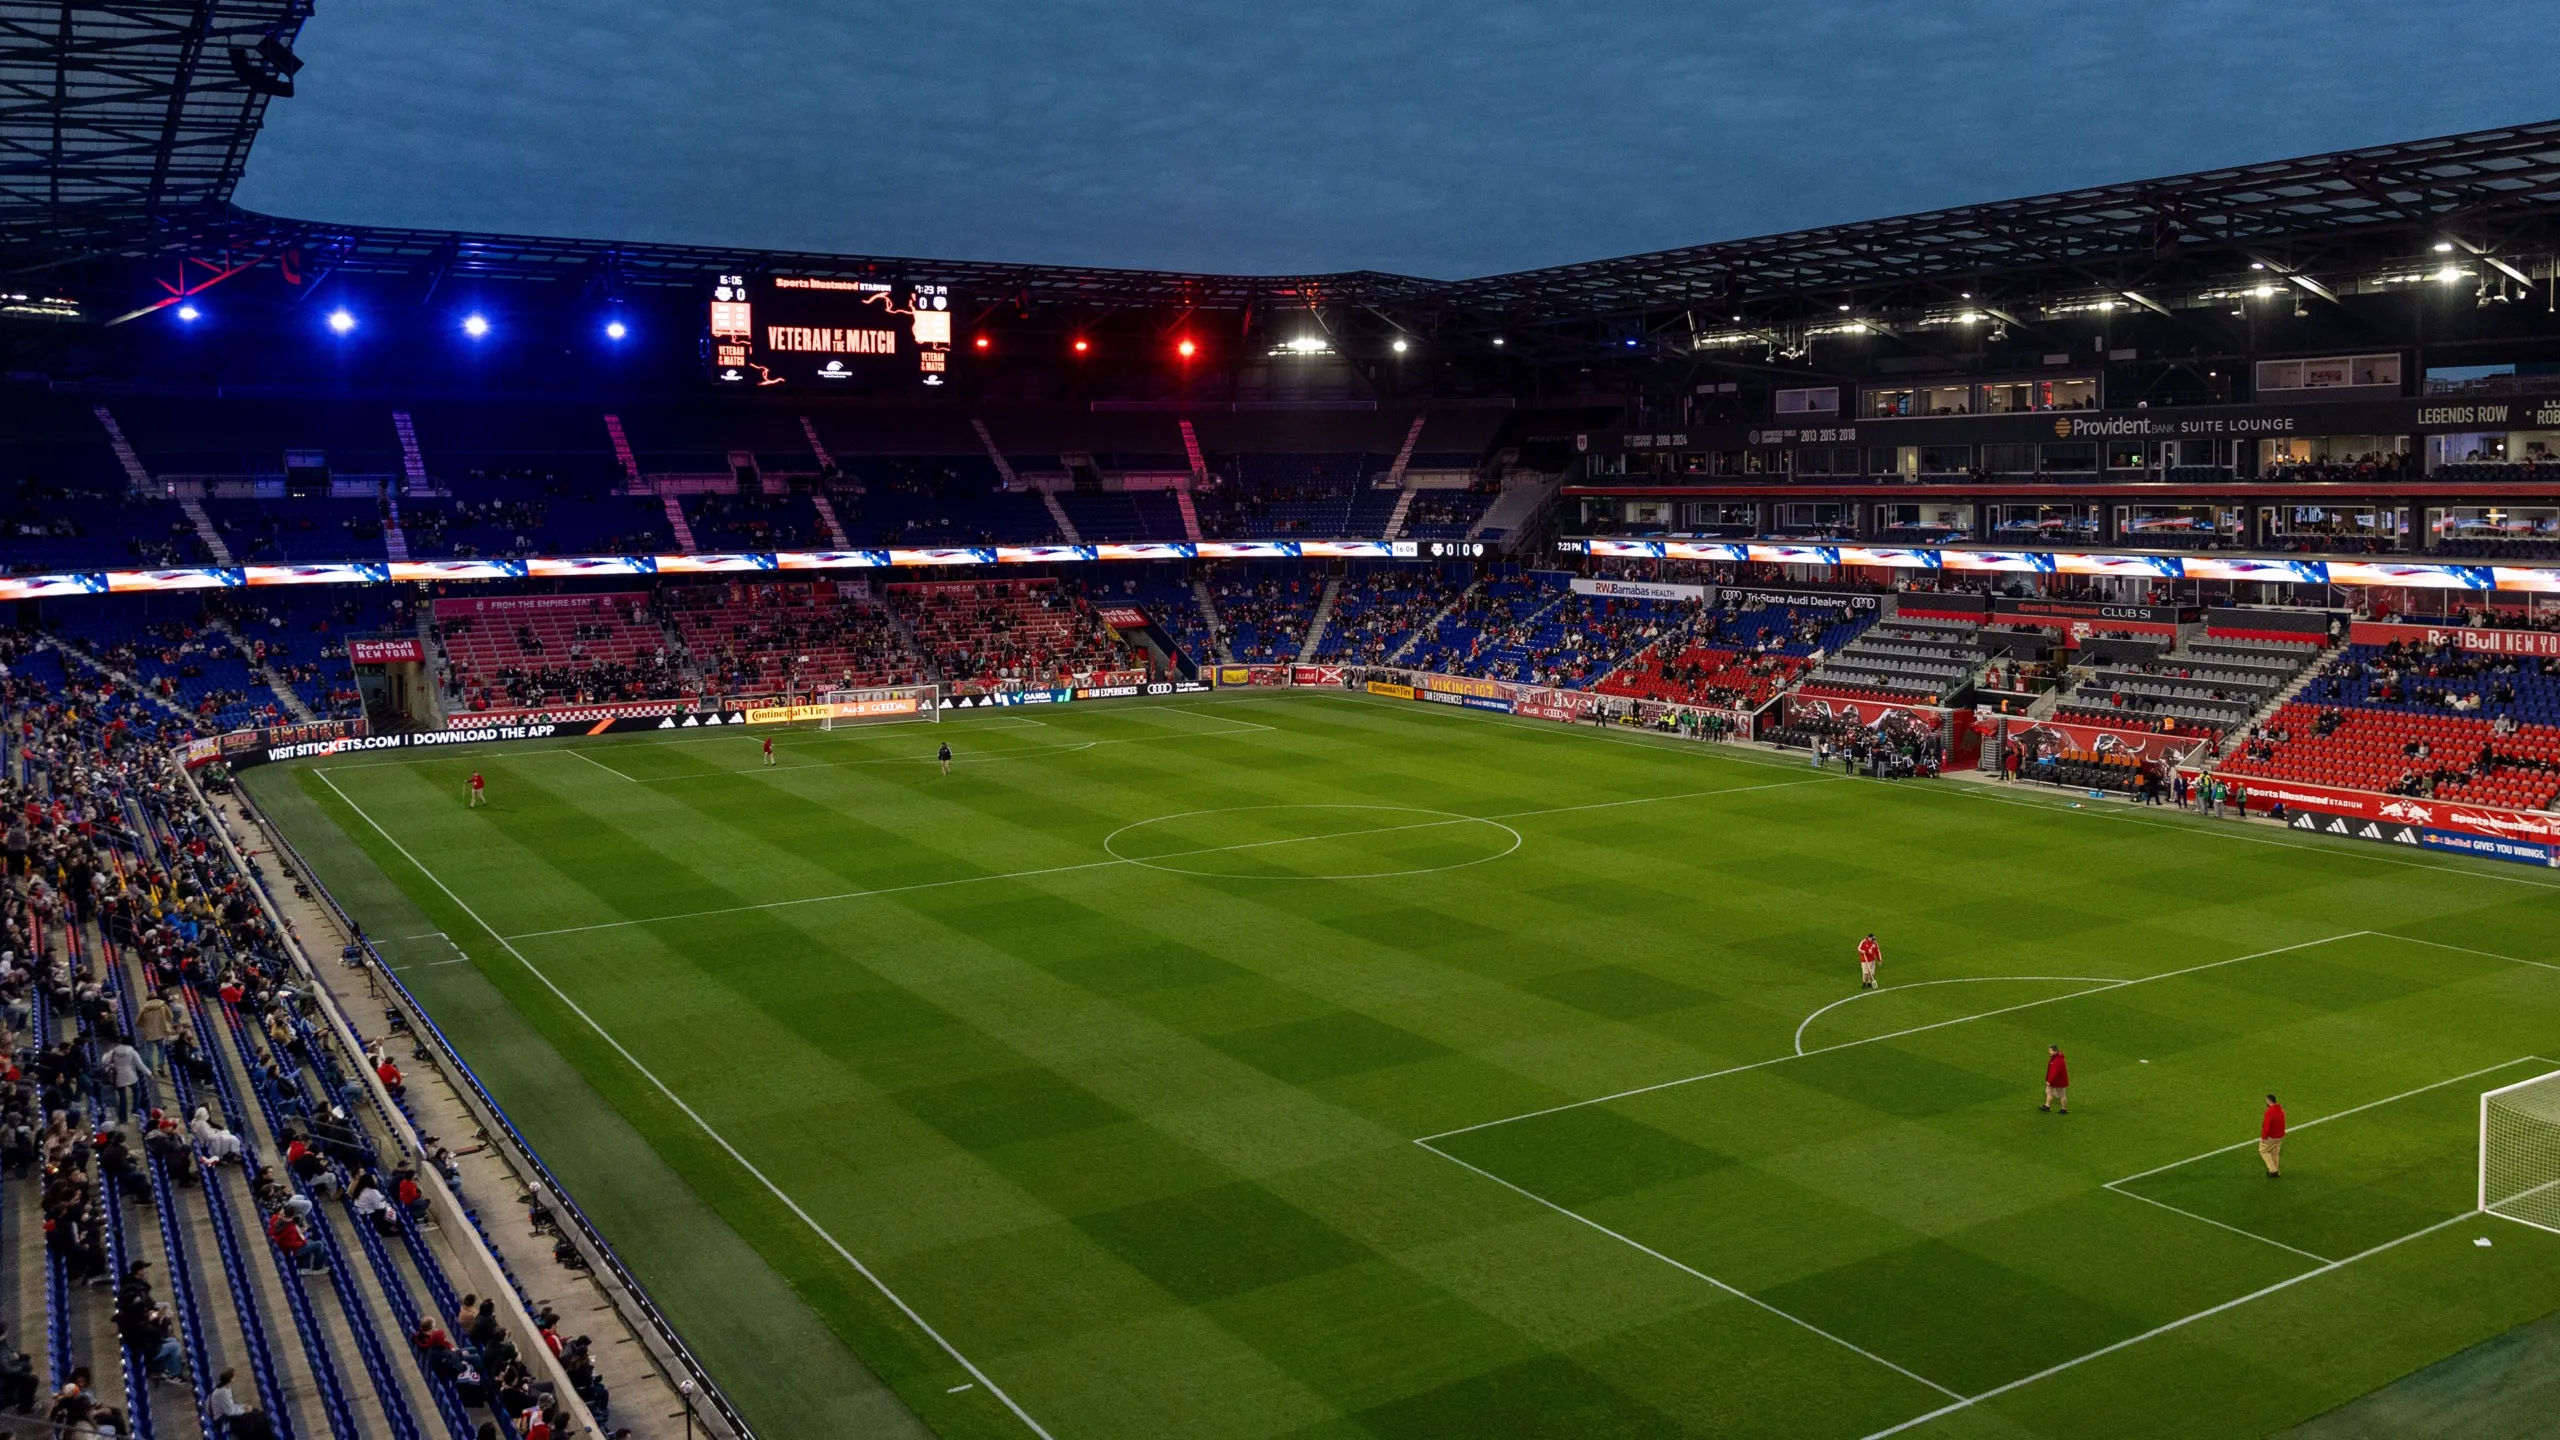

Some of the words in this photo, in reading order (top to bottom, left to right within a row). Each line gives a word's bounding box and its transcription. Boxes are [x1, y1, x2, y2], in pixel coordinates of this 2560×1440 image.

[776, 278, 809, 288] Sports
[810, 279, 859, 290] Illustrated
[860, 283, 892, 291] STADIUM
[737, 288, 746, 301] 0
[919, 297, 928, 309] 0
[768, 326, 831, 351] VETERAN
[834, 329, 843, 340] OF
[833, 341, 845, 352] THE
[846, 329, 895, 354] MATCH
[719, 346, 744, 355] VETERAN
[921, 352, 944, 361] VETERAN
[2418, 406, 2474, 424] LEGENDS
[2478, 405, 2508, 422] ROW
[2073, 416, 2151, 436] Provident
[2151, 424, 2175, 434] BANK
[2181, 420, 2224, 433] SUITE
[2229, 418, 2293, 432] LOUNGE
[1800, 430, 1817, 442] 2013
[1820, 429, 1836, 441] 2015
[1839, 428, 1856, 441] 2018
[1446, 544, 1453, 556] 0
[1463, 544, 1470, 556] 0
[1557, 542, 1571, 551] 7:23
[1572, 543, 1581, 551] PM
[537, 600, 569, 608] EMPIRE
[1746, 592, 1785, 604] Tri-State
[1787, 595, 1808, 605] Audi
[1811, 597, 1846, 607] Dealers
[2018, 603, 2049, 613] Sports
[2051, 604, 2099, 615] Illustrated
[2101, 607, 2136, 617] CLUB
[2139, 609, 2151, 619] SI
[356, 642, 384, 651] Red
[385, 641, 412, 650] Bull
[2428, 630, 2462, 647] Red
[2465, 632, 2500, 650] Bull
[2506, 633, 2534, 652] NEW
[358, 650, 381, 658] NEW
[385, 649, 415, 657] YORK
[1077, 689, 1088, 698] SI
[1089, 687, 1099, 697] FAN
[1101, 686, 1138, 696] EXPERIENCES
[1371, 683, 1397, 694] Continental
[1400, 688, 1411, 696] Tire
[1431, 679, 1472, 695] VIKING
[1476, 684, 1494, 698] 107
[1024, 692, 1051, 700] OANDA
[1424, 690, 1433, 702] FAN
[1433, 692, 1462, 705] EXPERIENCES
[752, 708, 800, 722] Continental
[810, 706, 828, 715] Tire
[842, 706, 865, 714] Audi
[1523, 706, 1539, 714] Audi
[269, 723, 345, 745] EMPIRE
[268, 746, 295, 761] VISIT
[296, 735, 400, 755] SITICKETS.COM
[413, 729, 497, 745] DOWNLOAD
[500, 726, 526, 739] THE
[528, 725, 555, 737] APP
[2247, 787, 2279, 798] Sports
[2279, 791, 2328, 805] Illustrated
[2329, 799, 2363, 809] STADIUM
[2451, 813, 2489, 827] Sports
[2473, 840, 2494, 851] GIVES
[2496, 843, 2512, 854] YOU
